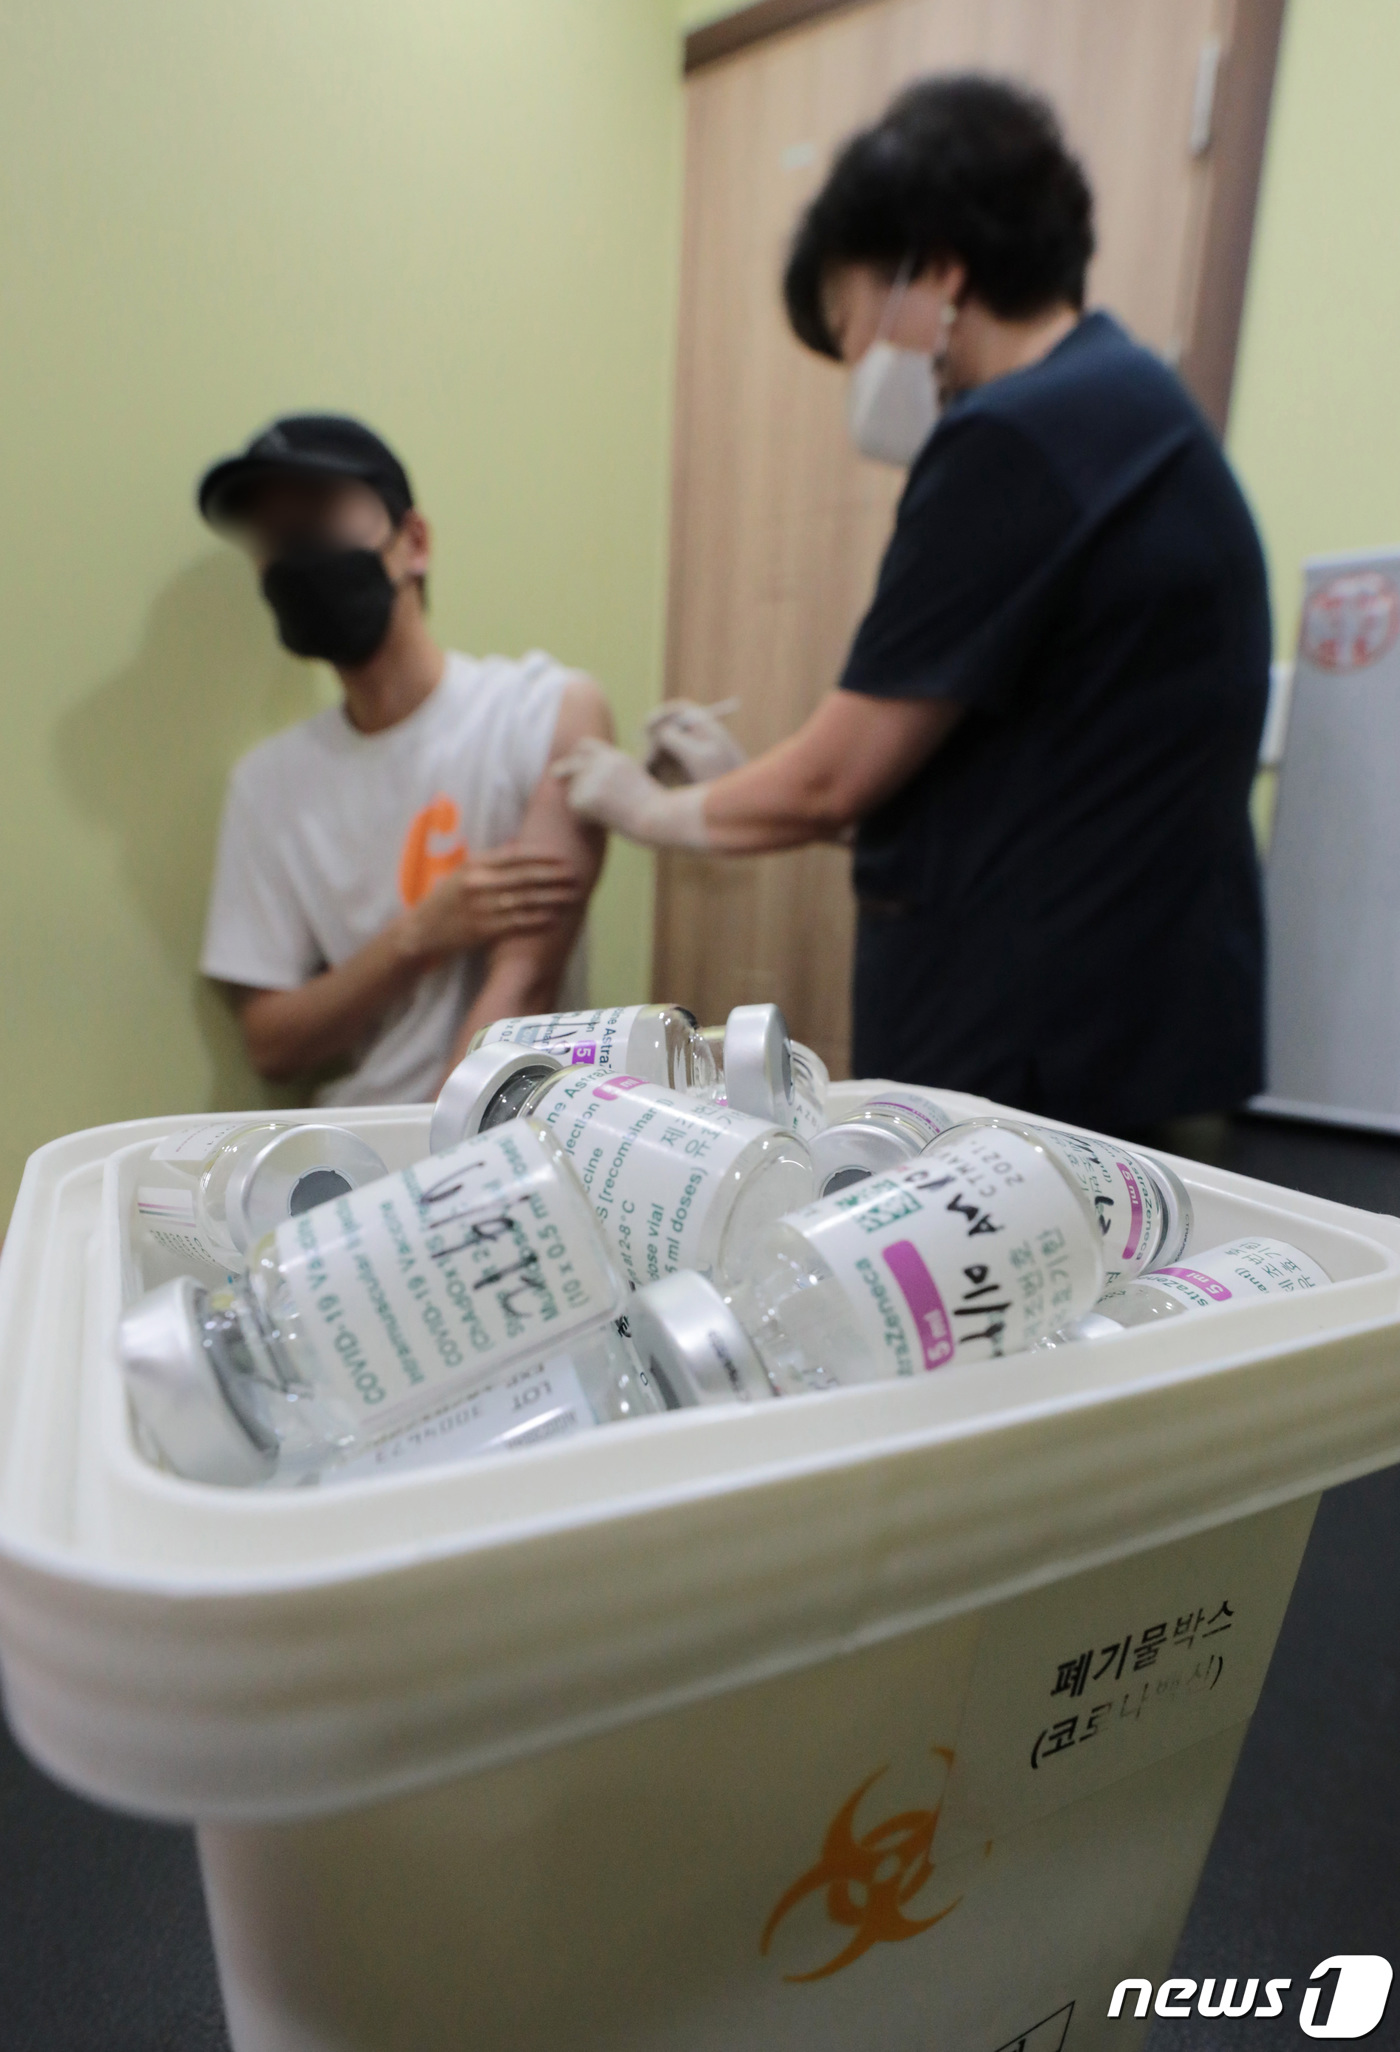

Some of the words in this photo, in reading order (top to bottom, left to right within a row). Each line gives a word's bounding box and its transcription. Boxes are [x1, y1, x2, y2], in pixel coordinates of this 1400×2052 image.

[1128, 1184, 1139, 1205] ml
[644, 1200, 665, 1239] vial
[662, 1235, 680, 1263] ml
[671, 1168, 708, 1232] doses)
[538, 1224, 566, 1260] 0.5
[1187, 1271, 1209, 1285] ml
[1207, 1282, 1222, 1294] 5
[407, 1275, 462, 1367] COVID-19
[317, 1293, 387, 1405] COVID-19
[927, 1340, 952, 1361] 5
[1050, 1600, 1234, 1698] 폐기물박스
